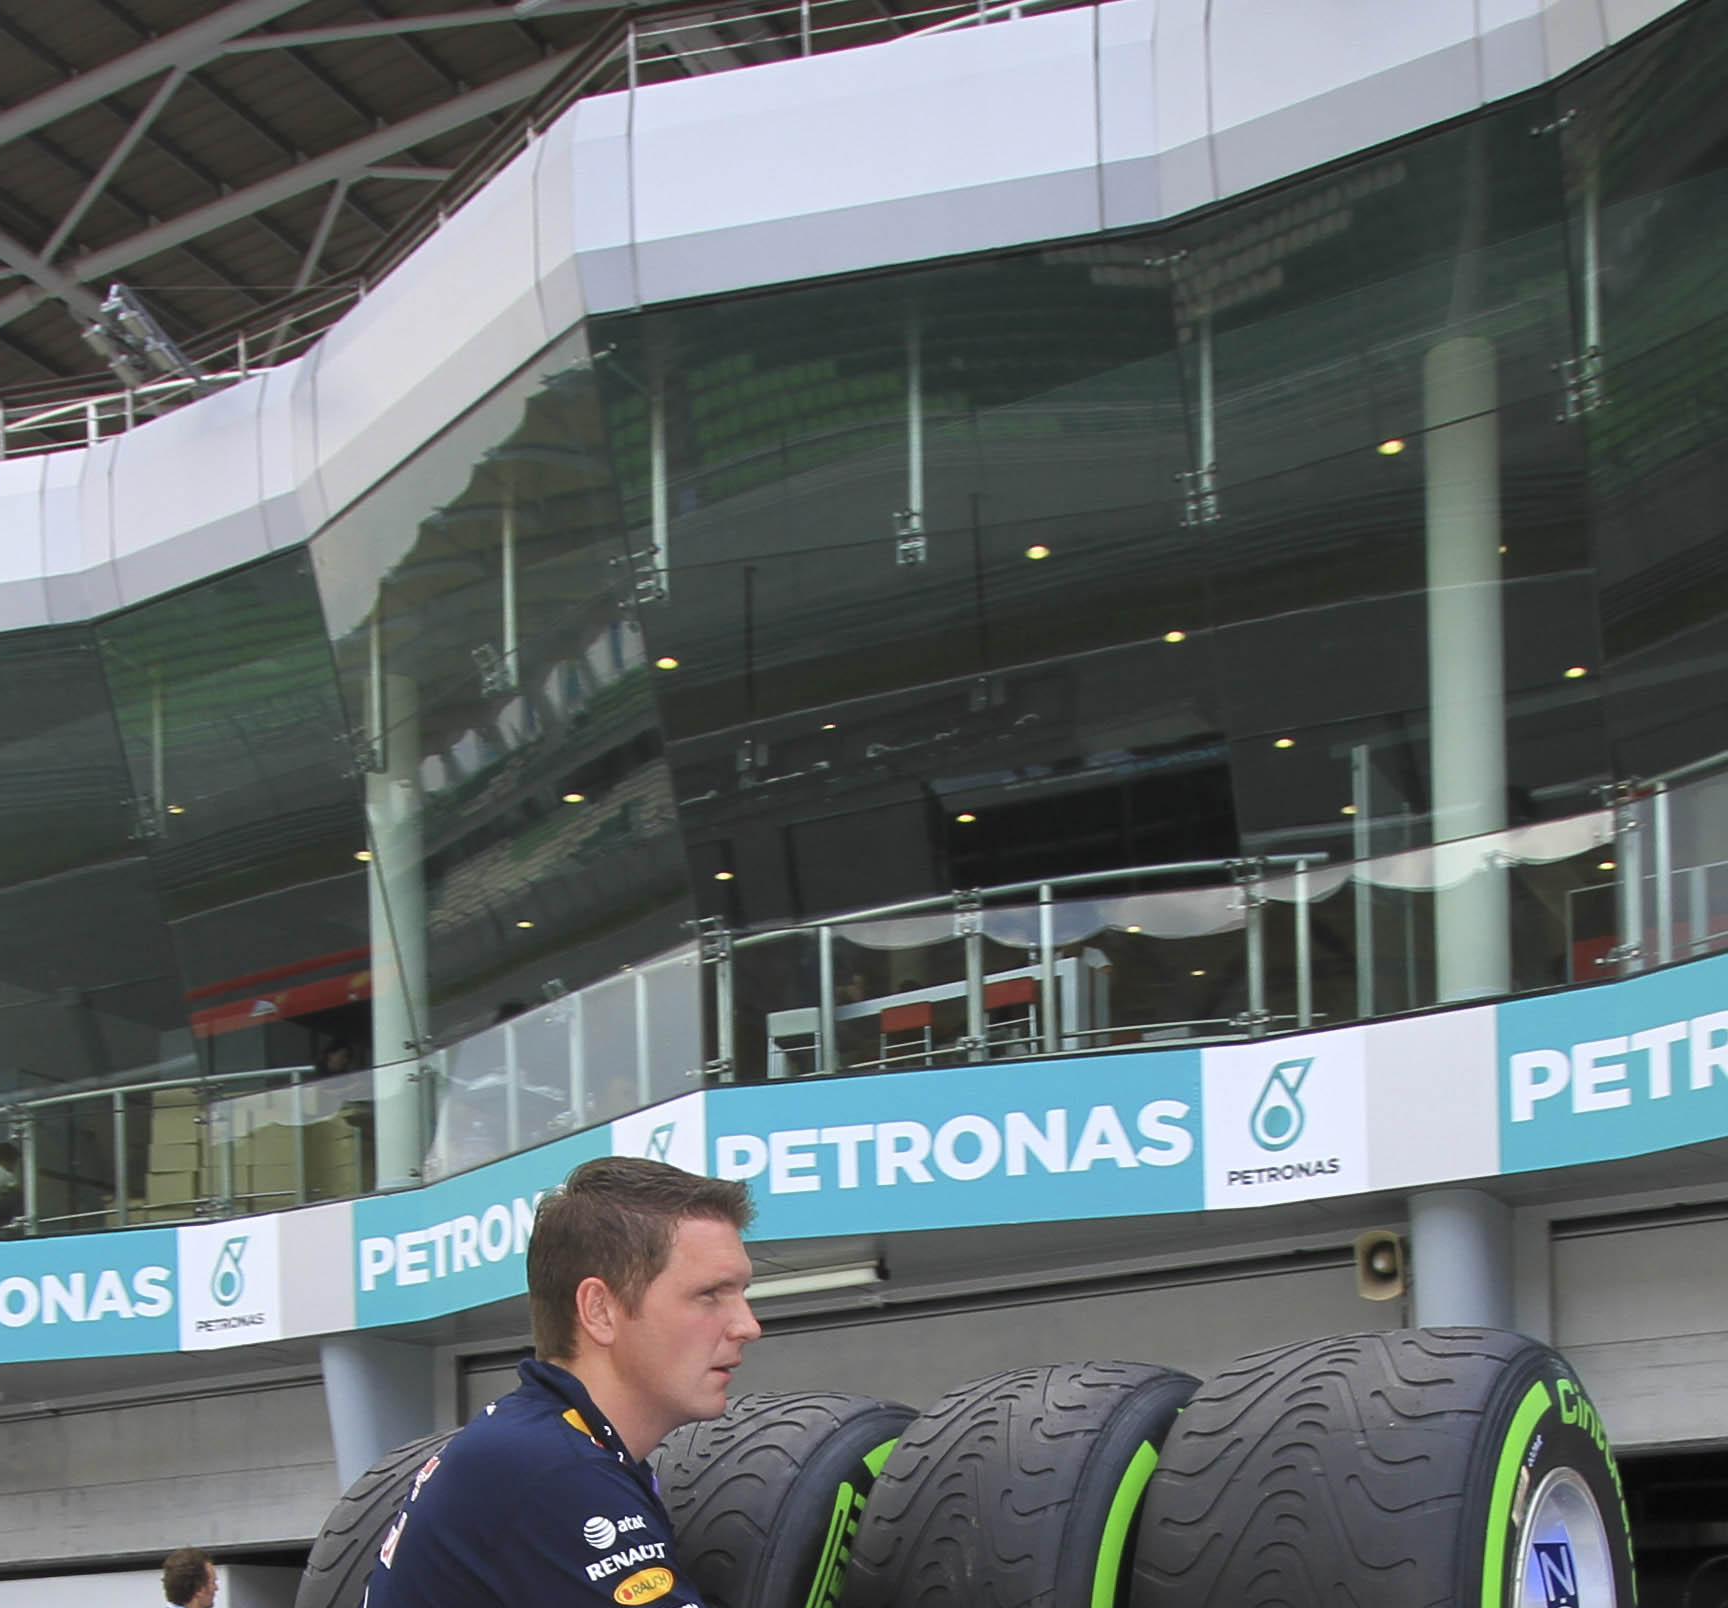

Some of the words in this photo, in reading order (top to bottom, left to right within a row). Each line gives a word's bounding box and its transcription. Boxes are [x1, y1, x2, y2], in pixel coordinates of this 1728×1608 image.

[715, 1099, 1193, 1195] PETRONAS
[1226, 1156, 1341, 1187] PETRONAS
[194, 1312, 266, 1333] PETRONAS
